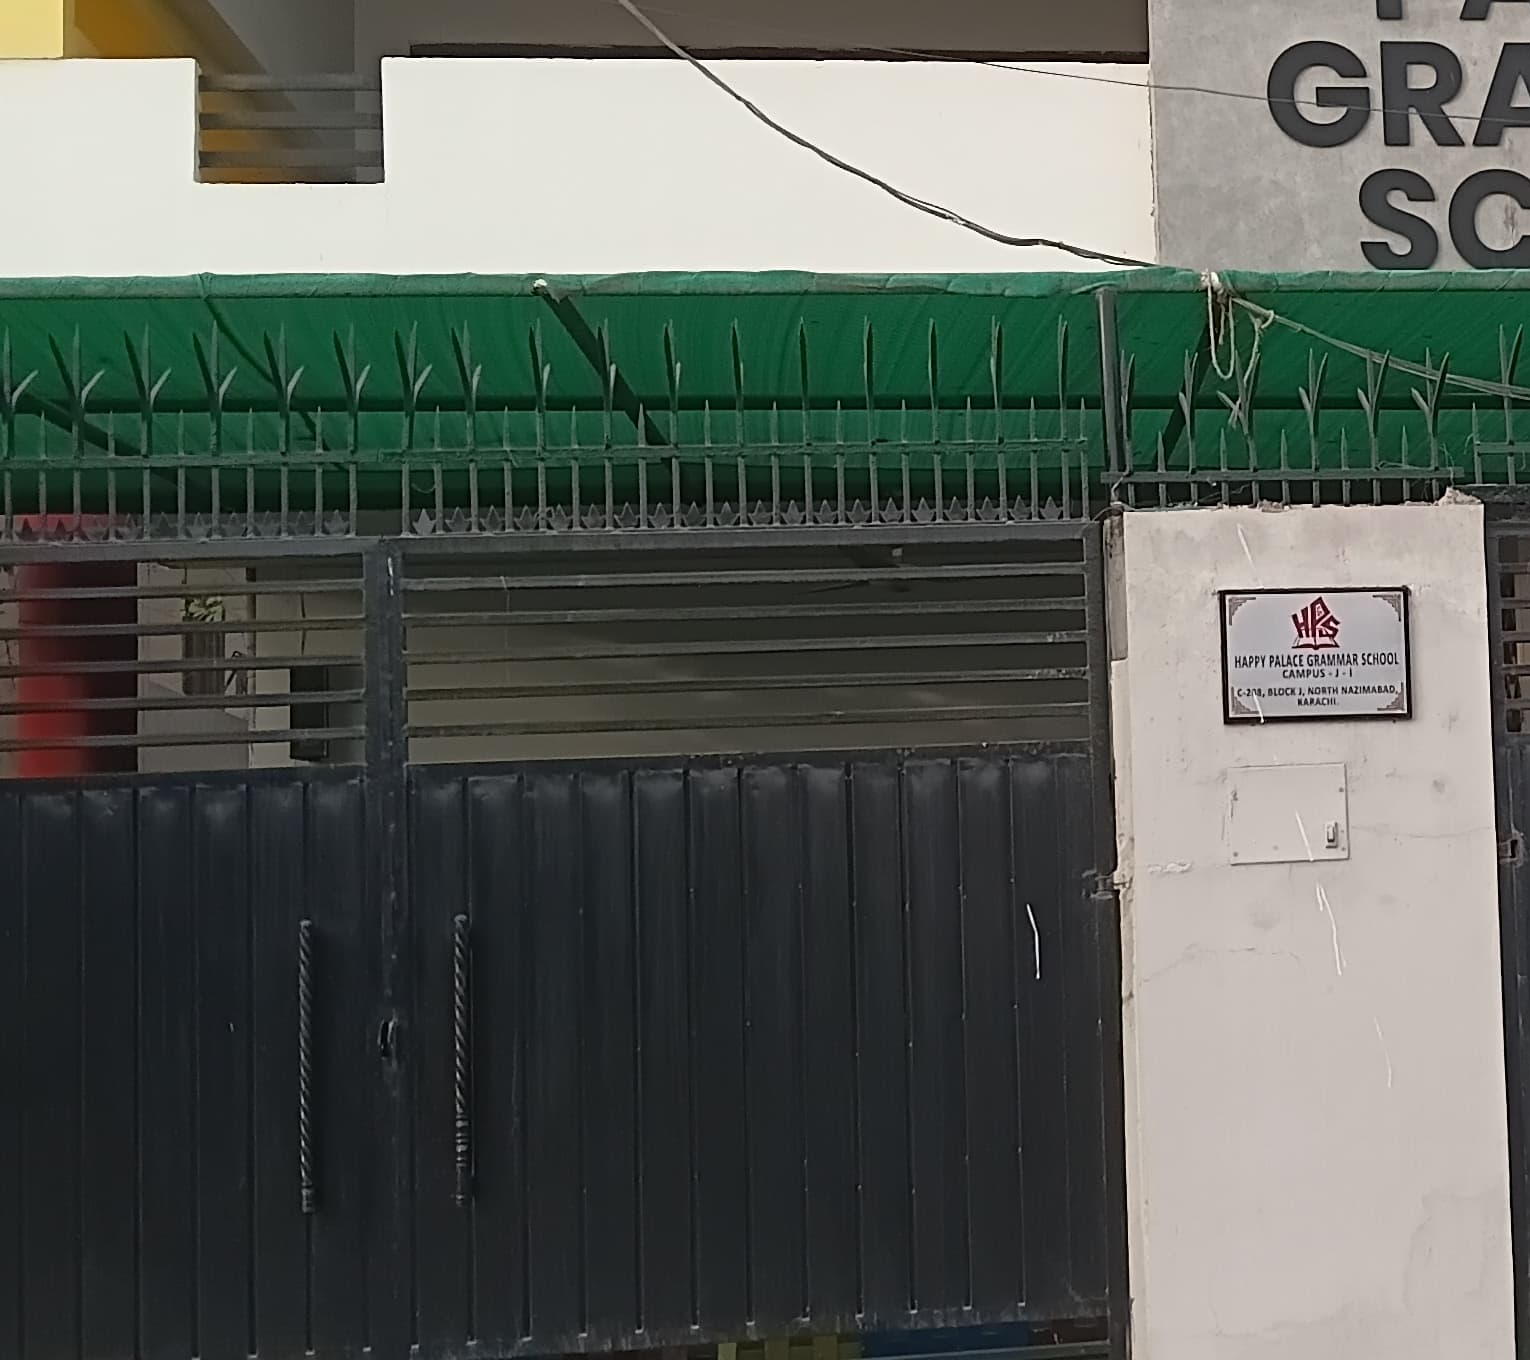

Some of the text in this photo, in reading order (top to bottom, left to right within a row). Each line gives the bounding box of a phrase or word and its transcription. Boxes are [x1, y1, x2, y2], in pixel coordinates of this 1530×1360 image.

[1234, 652, 1399, 669] HAPPY PALACE GRAMMAR SCHOOL
[1282, 669, 1325, 678] CAMPUS
[1267, 687, 1296, 697] BLOCK
[1307, 686, 1339, 696] NORTH
